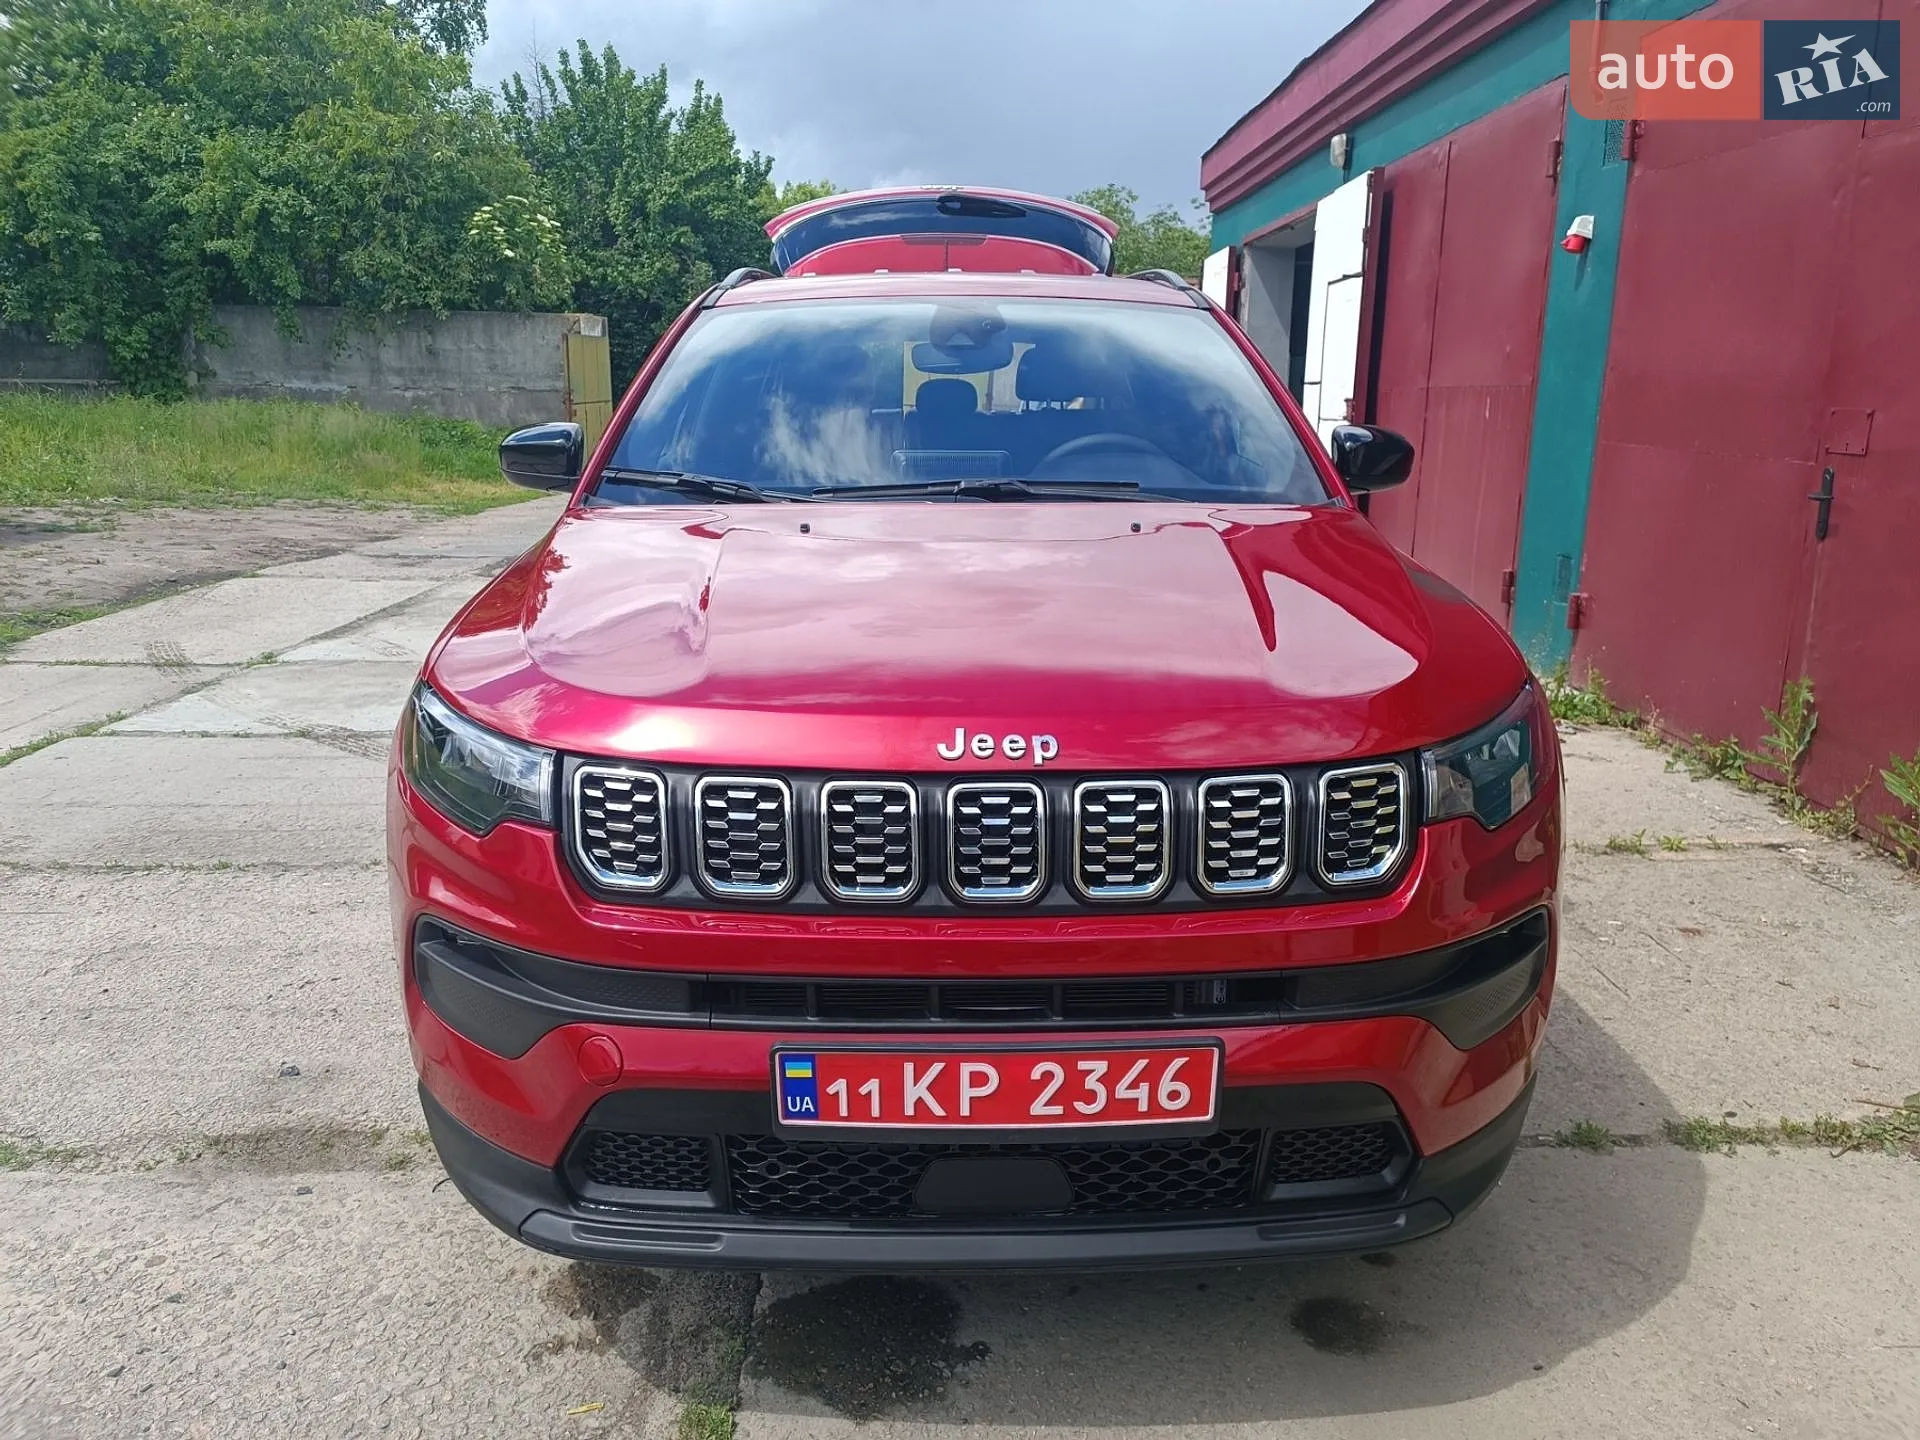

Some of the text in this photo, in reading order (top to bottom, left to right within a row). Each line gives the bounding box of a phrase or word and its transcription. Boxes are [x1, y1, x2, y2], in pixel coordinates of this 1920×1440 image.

[936, 727, 1059, 765] Jeep
[787, 1096, 816, 1113] UA
[825, 1057, 1191, 1117] 11 KP 2346
